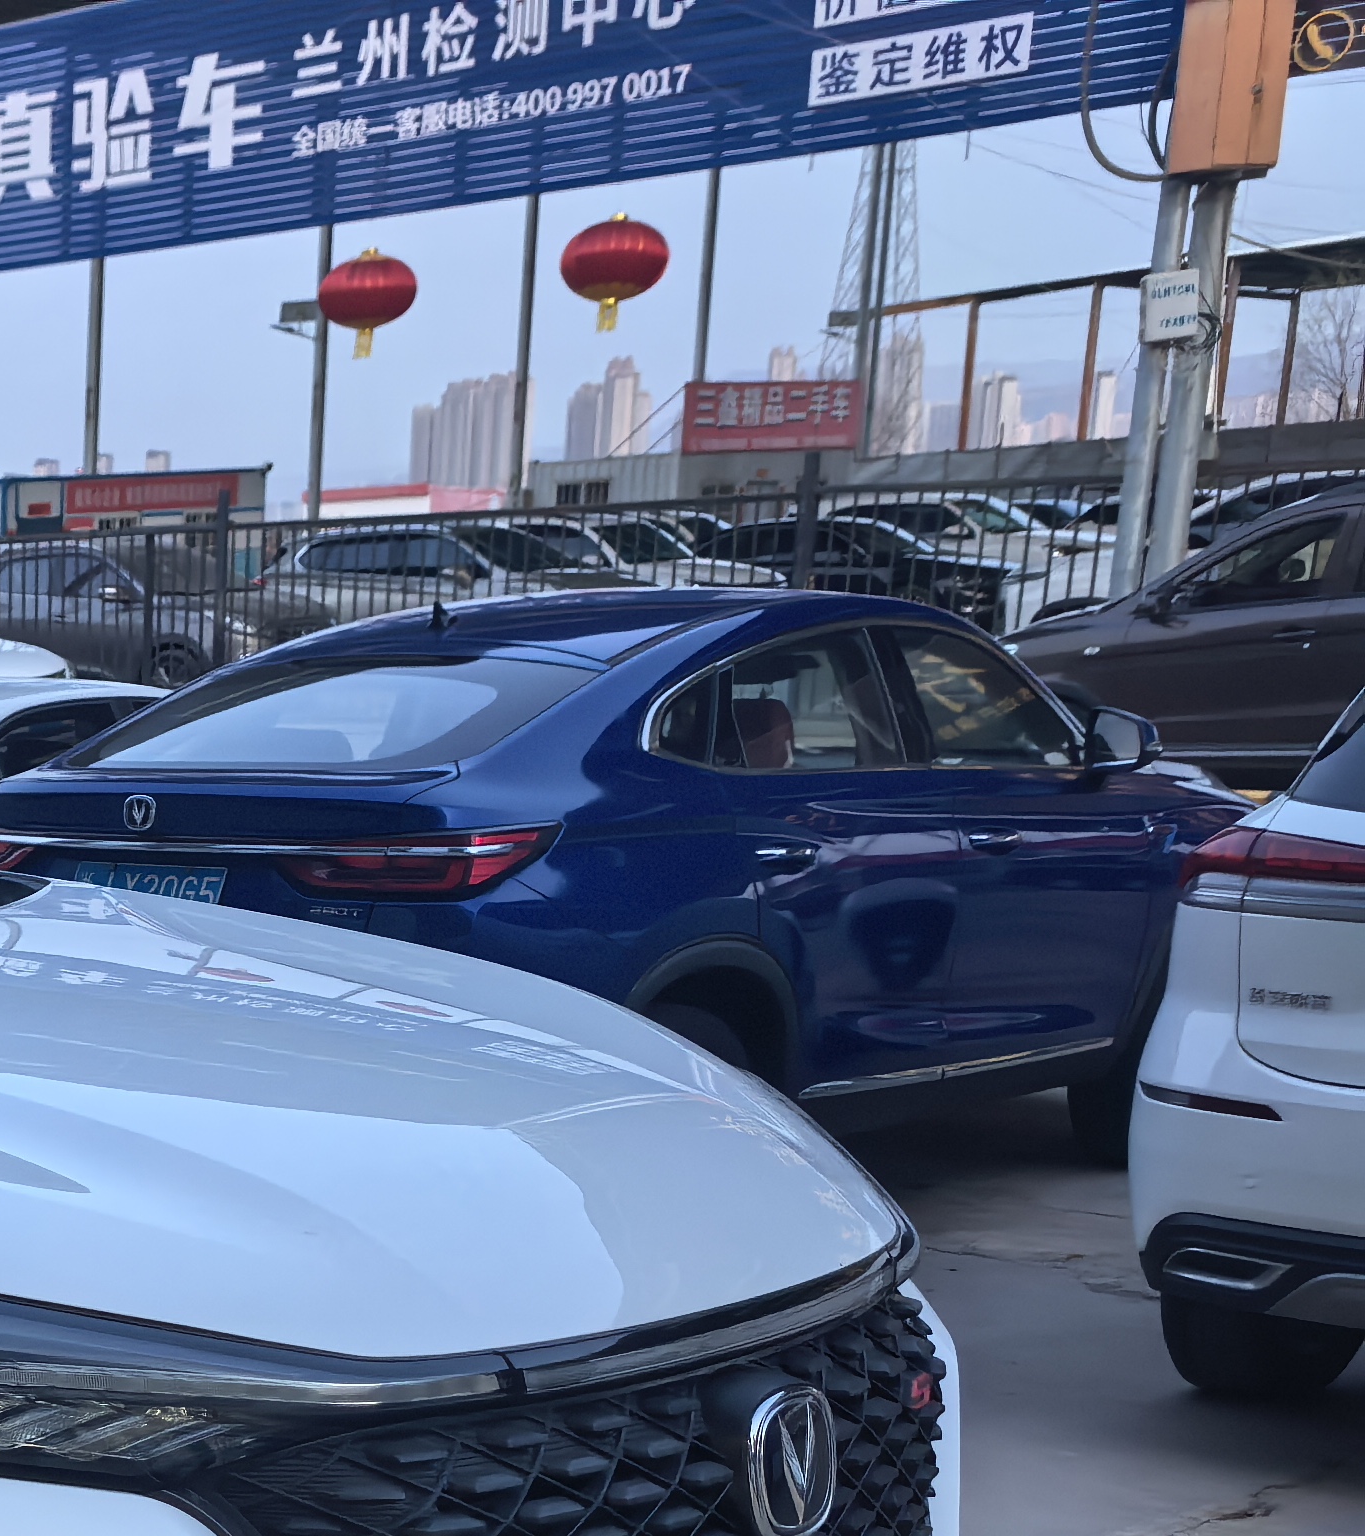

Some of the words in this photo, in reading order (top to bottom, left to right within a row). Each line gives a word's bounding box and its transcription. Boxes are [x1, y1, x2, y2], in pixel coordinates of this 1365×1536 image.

[568, 75, 618, 110] 997
[622, 63, 692, 100] 0017
[818, 24, 1024, 98] 鉴定维权
